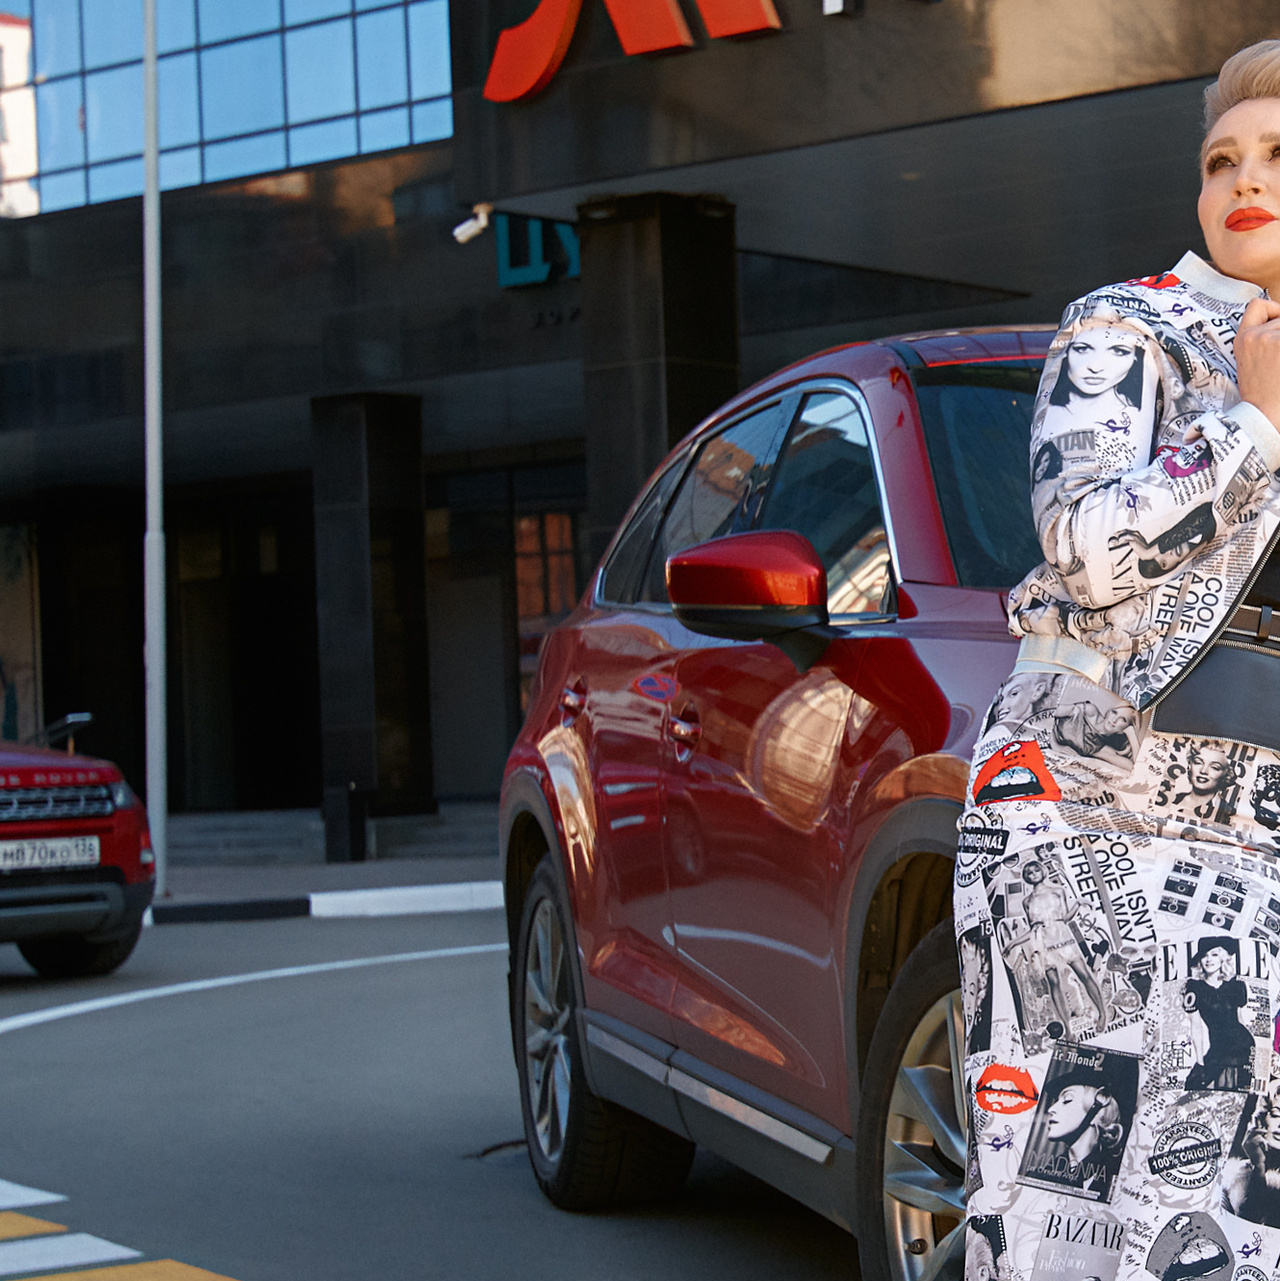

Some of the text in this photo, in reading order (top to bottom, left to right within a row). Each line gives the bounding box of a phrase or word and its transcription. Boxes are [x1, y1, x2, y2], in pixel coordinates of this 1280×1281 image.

[1191, 576, 1223, 634] COOL
[1110, 894, 1137, 943] WAY
[1125, 888, 1157, 943] ISN'T
[1045, 1213, 1124, 1251] BAZAAR
